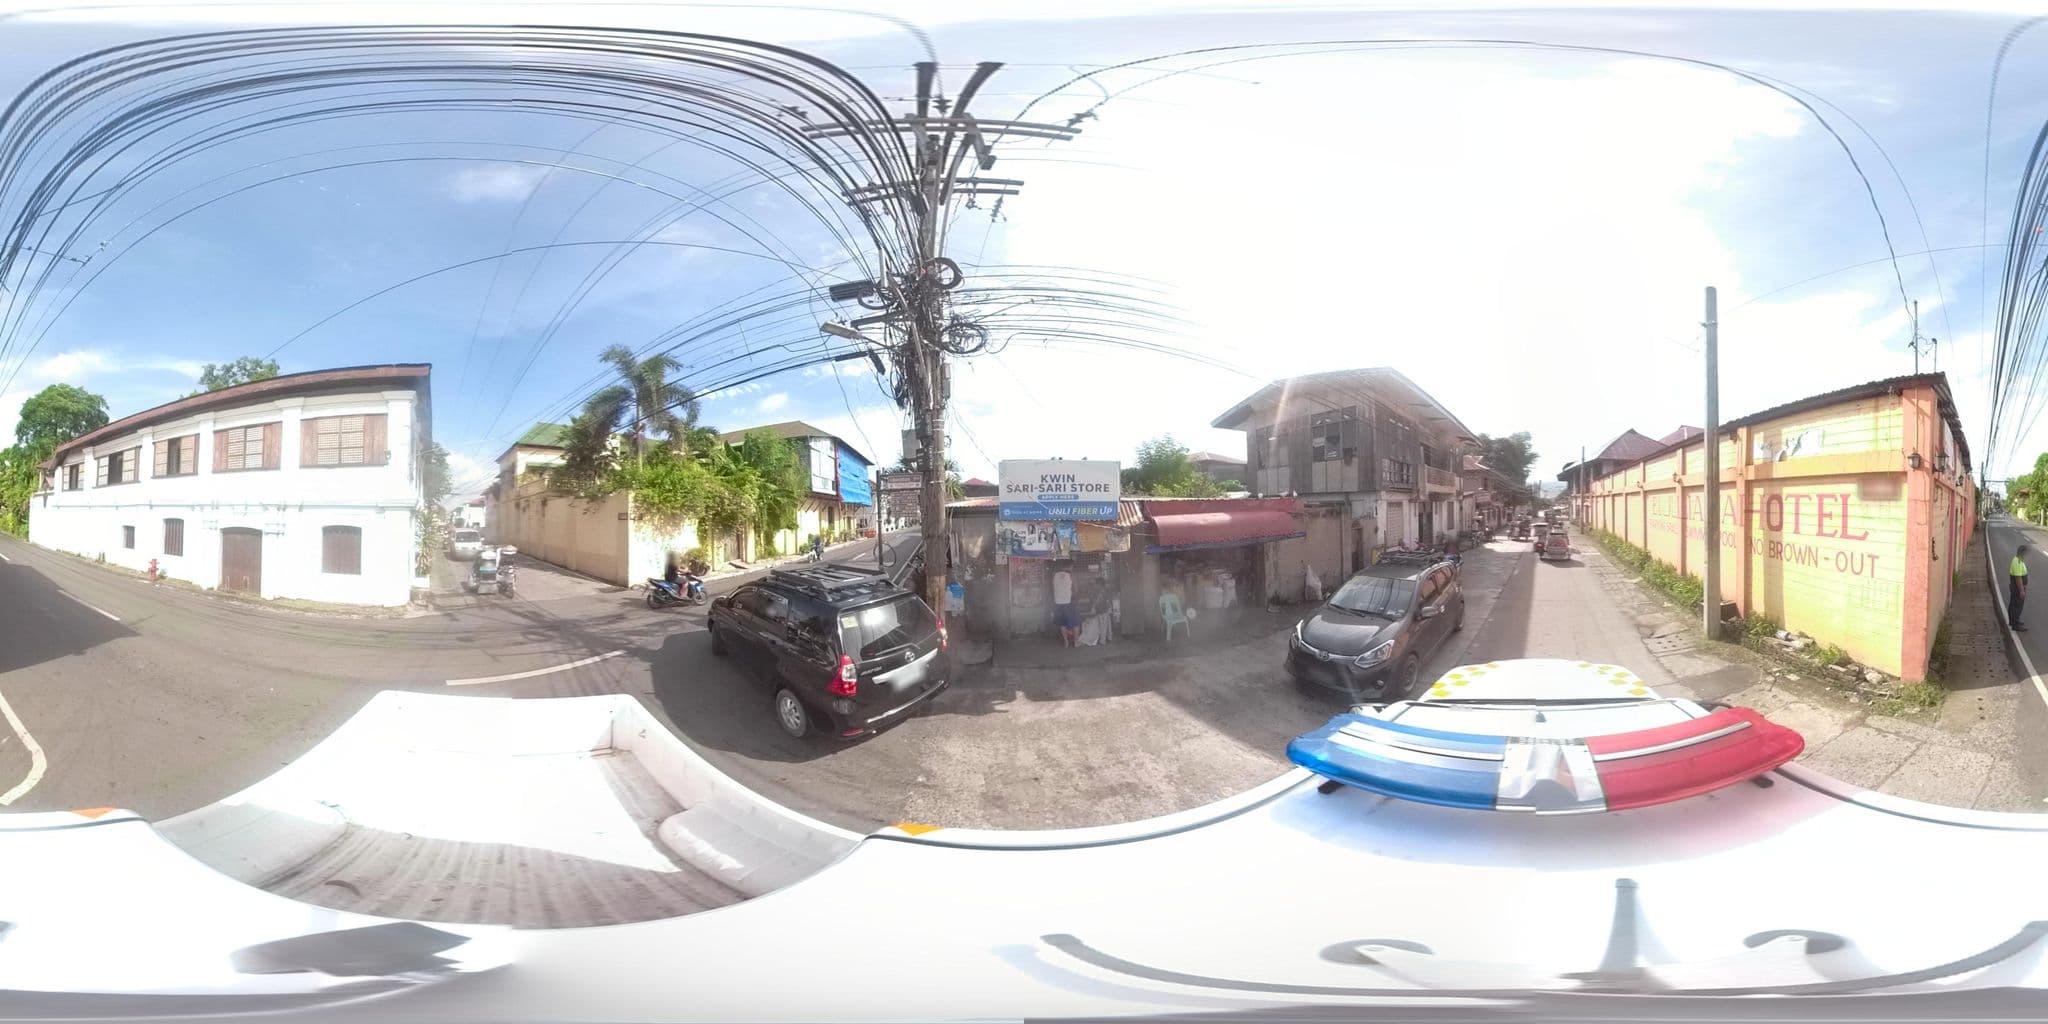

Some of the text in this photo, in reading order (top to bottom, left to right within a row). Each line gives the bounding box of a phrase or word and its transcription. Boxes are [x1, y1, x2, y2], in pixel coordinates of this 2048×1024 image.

[1040, 474, 1076, 483] KWIN
[1006, 483, 1110, 493] SARI-SARI STORE
[1048, 507, 1070, 515] UNLI
[1072, 507, 1098, 515] FIBER
[1099, 506, 1113, 515] UP
[1740, 493, 1869, 541] HOTEL
[1768, 540, 1820, 569] BROWN
[1834, 551, 1880, 578] OUT
